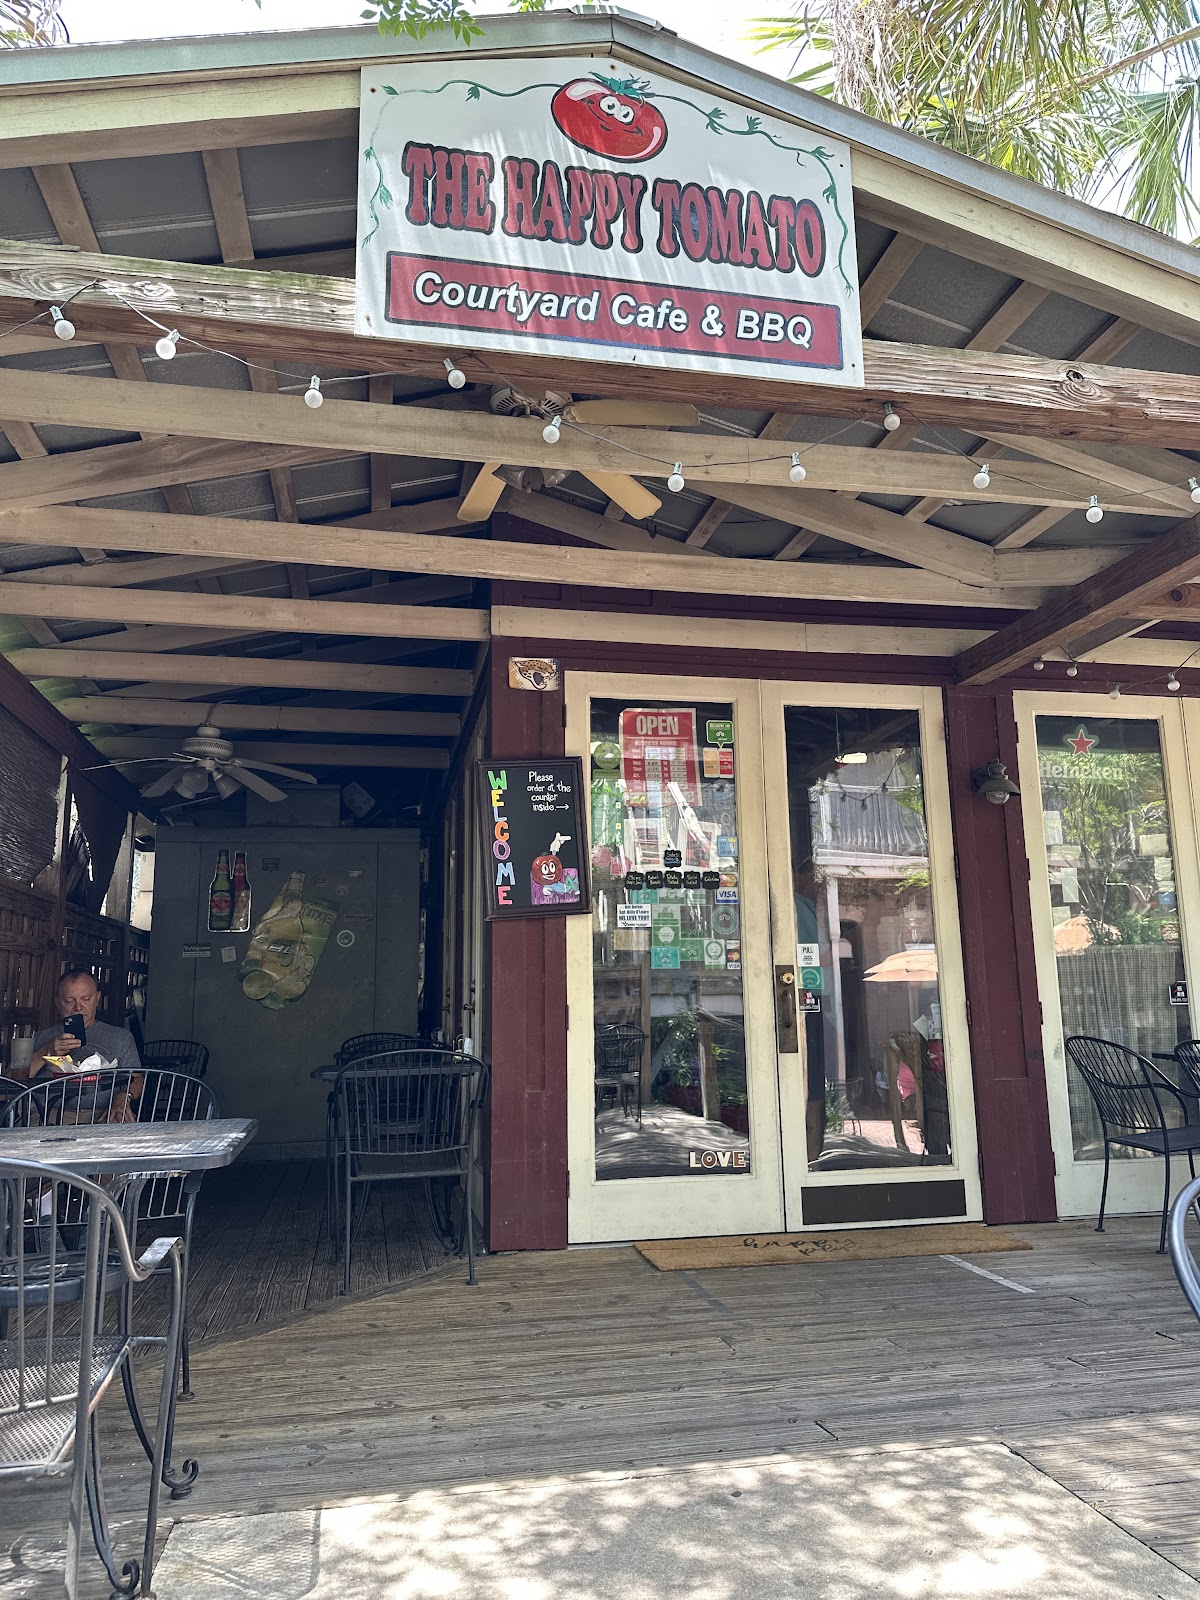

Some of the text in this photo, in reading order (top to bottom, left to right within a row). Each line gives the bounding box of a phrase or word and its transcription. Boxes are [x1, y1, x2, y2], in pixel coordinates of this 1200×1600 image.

[401, 140, 826, 278] THE HAPPY TOMATO
[414, 271, 813, 350] Courtyard Cafe & BBQ
[635, 715, 679, 736] OPEN
[528, 770, 553, 782] Please
[1040, 760, 1123, 780] Heineken
[526, 780, 572, 792] order at the
[531, 792, 558, 802] counter
[488, 770, 515, 905] WELCOME
[719, 890, 737, 898] VISA
[303, 906, 333, 926] LIME
[689, 1150, 746, 1168] LOVE
